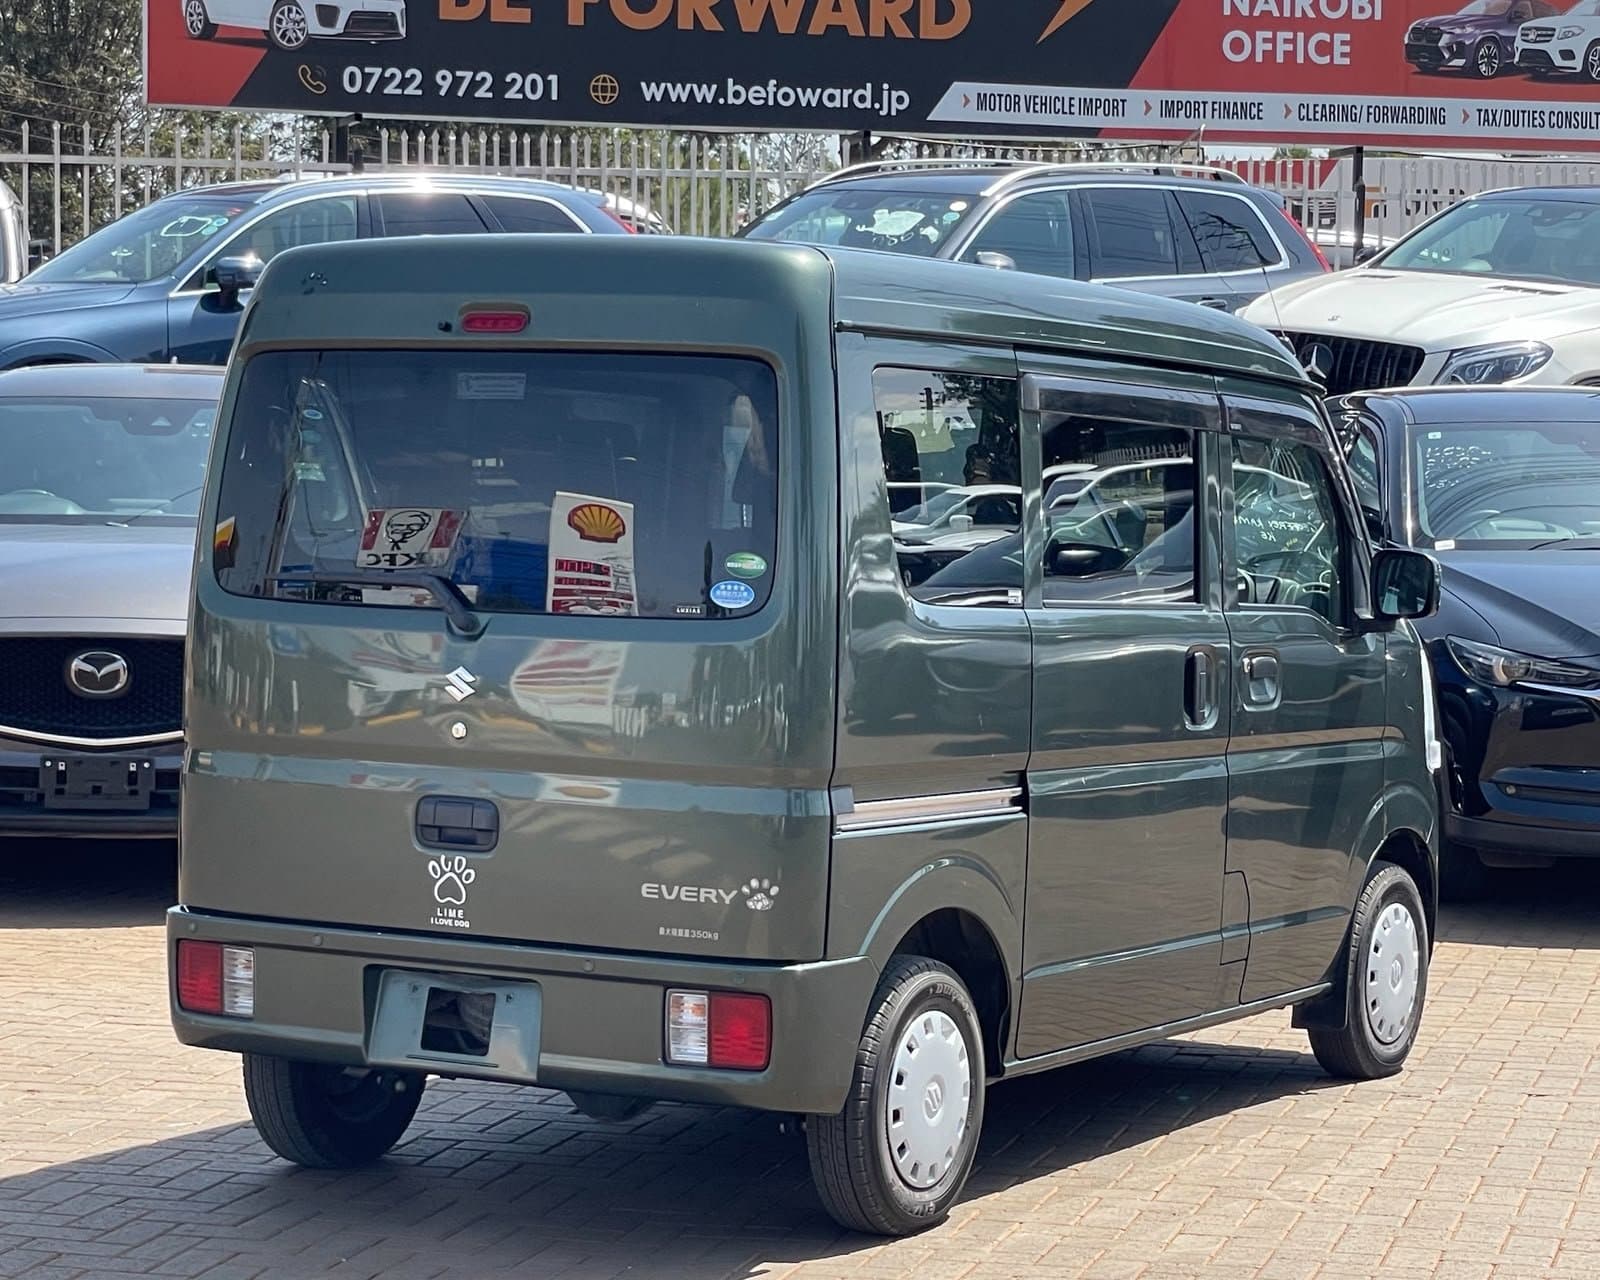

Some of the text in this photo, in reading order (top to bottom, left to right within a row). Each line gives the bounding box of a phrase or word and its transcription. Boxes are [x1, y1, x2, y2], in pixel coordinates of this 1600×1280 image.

[1223, 0, 1382, 20] NAIROBI
[1222, 30, 1350, 65] OFFICE
[343, 66, 558, 100] 0722 972 201
[640, 78, 910, 116] www.befoward.jp
[976, 92, 1127, 117] MOTOR VEHICLE IMPORT
[1160, 99, 1264, 120] IMPORT FINANCE
[1297, 102, 1446, 125] CLEARING/ FORWARDING
[1476, 108, 1545, 128] TAX/DUTIES
[640, 882, 738, 905] EVERY
[434, 917, 453, 927] LOVE
[437, 907, 464, 919] LIME
